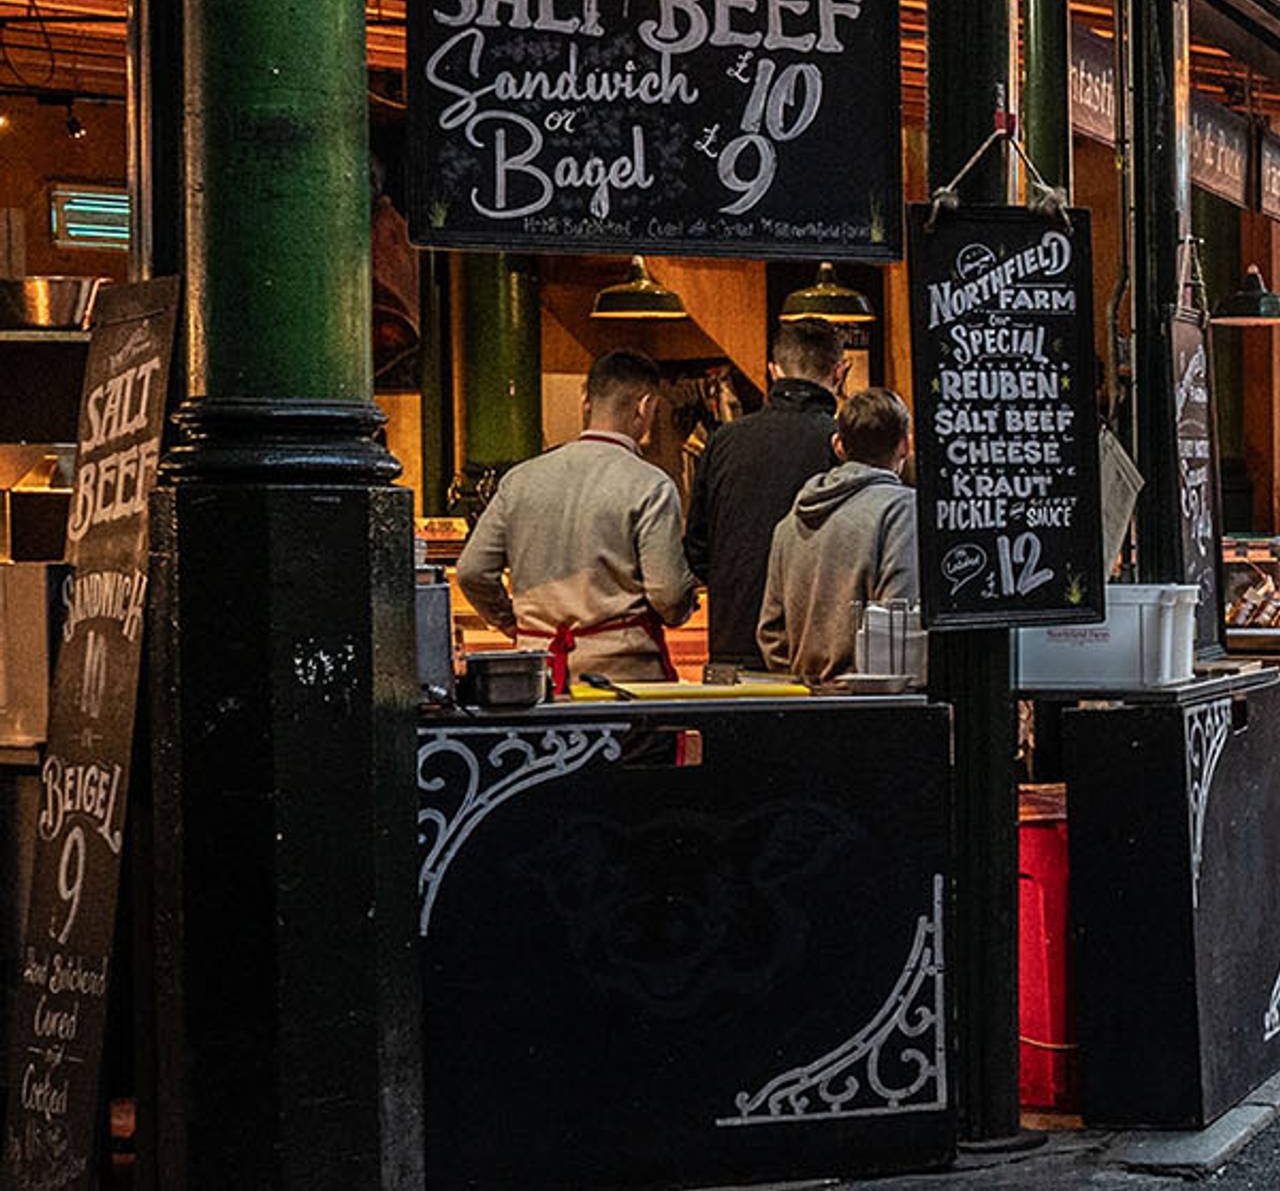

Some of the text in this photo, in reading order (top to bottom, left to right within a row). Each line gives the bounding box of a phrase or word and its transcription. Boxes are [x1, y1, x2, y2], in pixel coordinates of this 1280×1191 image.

[427, 29, 823, 140] Sandwich £10
[545, 111, 577, 133] or
[466, 111, 777, 219] Bagel £9
[928, 230, 1072, 329] NORTHFIELD
[1000, 289, 1075, 310] FARM
[951, 324, 1049, 364] SPECIAL
[82, 357, 161, 453] SALT
[940, 370, 1059, 401] REUBEN
[934, 410, 1074, 435] SALT BEEF
[946, 440, 1062, 464] CHEESE
[68, 438, 157, 541] BEEF
[952, 474, 1053, 497] KRAUT
[935, 499, 1008, 531] PICKLE
[1026, 507, 1073, 527] SAUCE
[980, 531, 1055, 597] £12
[62, 568, 149, 644] SANDWICH
[40, 755, 122, 854] BEIGEL
